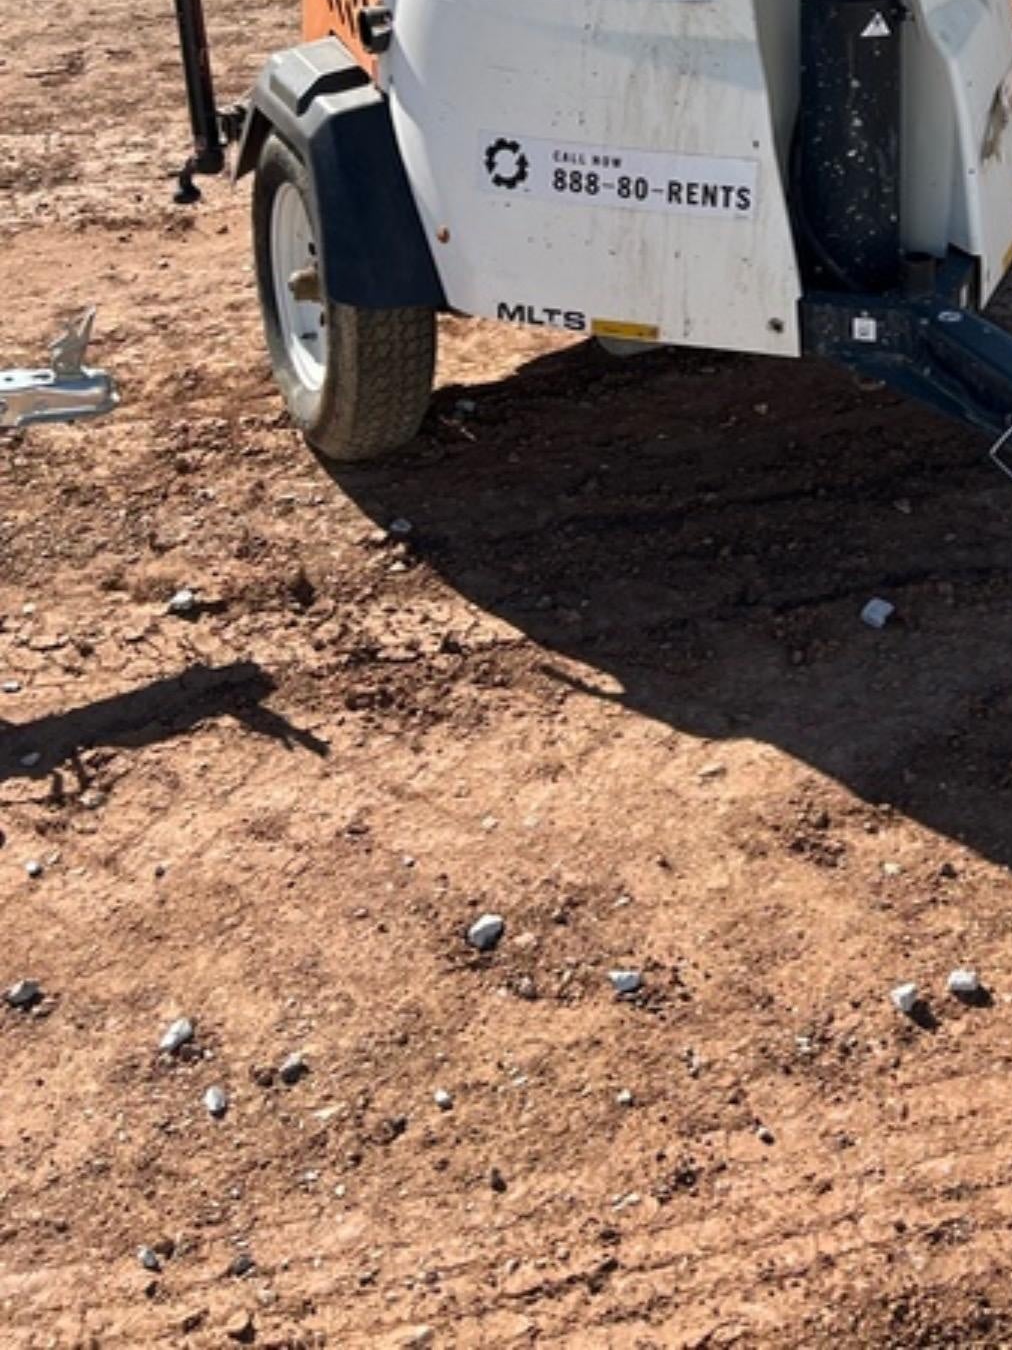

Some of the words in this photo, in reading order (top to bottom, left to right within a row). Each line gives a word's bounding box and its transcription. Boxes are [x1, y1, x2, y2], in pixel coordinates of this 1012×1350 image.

[553, 150, 586, 166] CALL
[592, 155, 622, 169] NOW
[552, 167, 752, 211] 888-80-RENTS
[497, 302, 587, 331] MLTS
